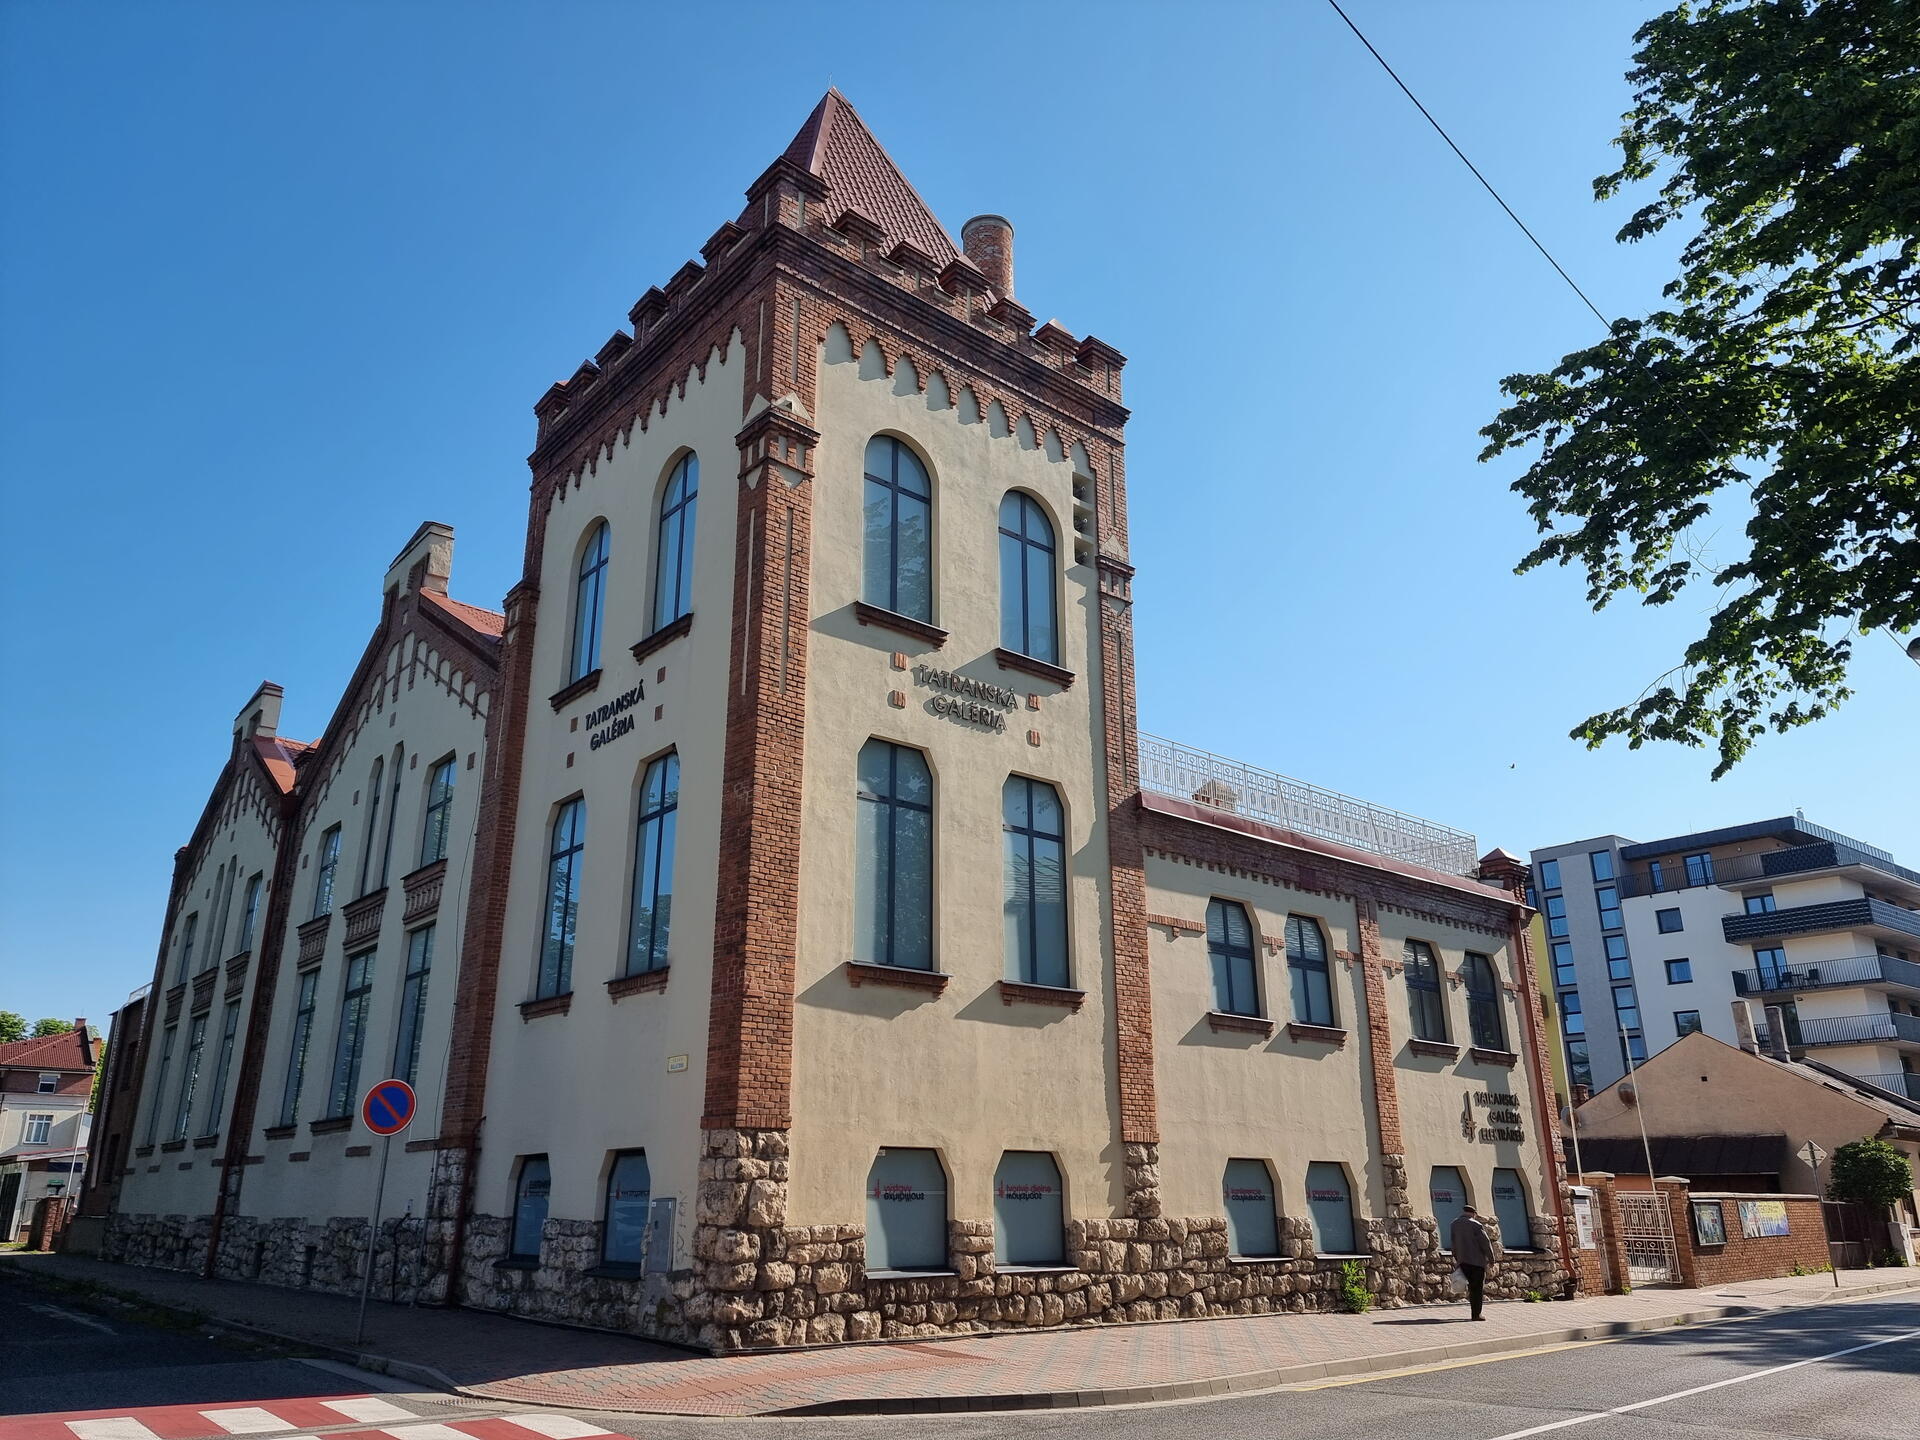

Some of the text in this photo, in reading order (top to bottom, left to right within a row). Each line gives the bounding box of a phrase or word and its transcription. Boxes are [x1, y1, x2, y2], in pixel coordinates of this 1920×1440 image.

[585, 678, 645, 731] TATRANSKÁ
[919, 664, 1019, 710] TATRANSKÁ
[590, 714, 635, 751] GALÉRIA
[933, 695, 1008, 732] GALÉRIA
